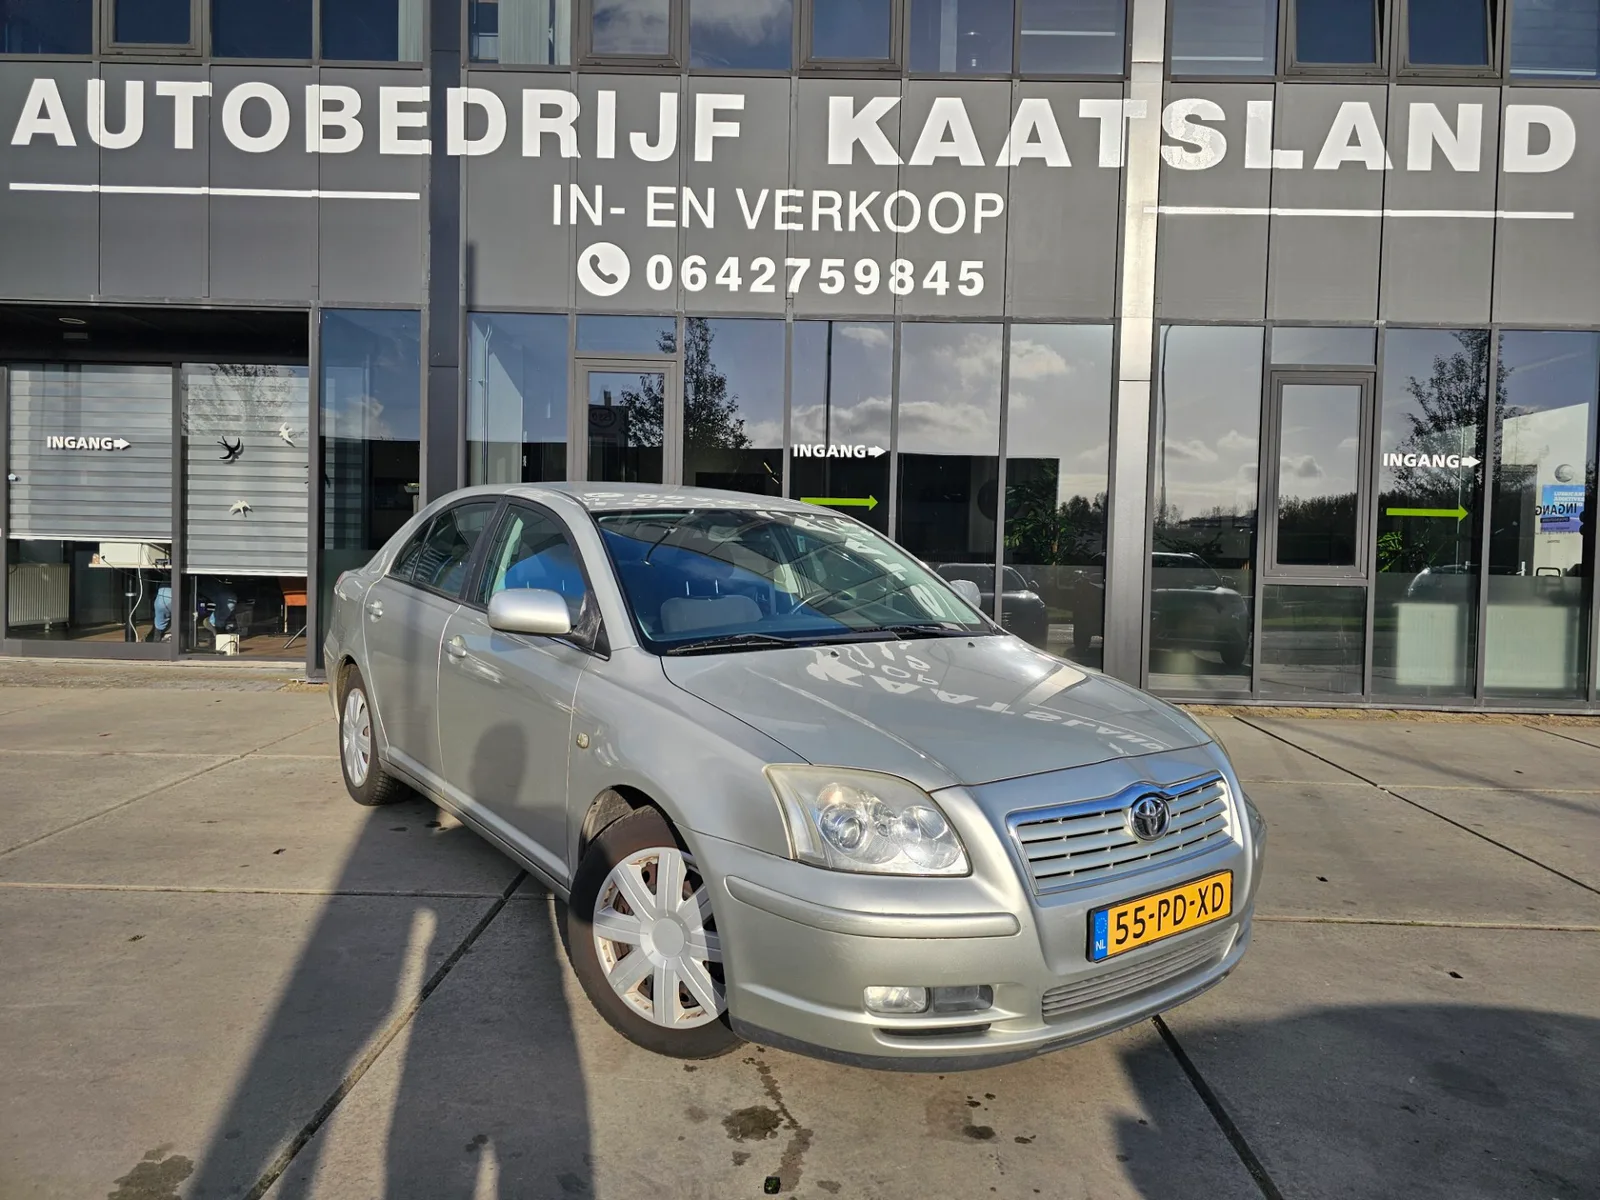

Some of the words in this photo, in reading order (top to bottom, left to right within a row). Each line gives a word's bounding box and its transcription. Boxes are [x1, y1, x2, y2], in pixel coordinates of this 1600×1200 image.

[11, 78, 746, 163] AUTOBEDRIJF
[828, 95, 1577, 173] KAATSLAND
[552, 183, 626, 227] IN-
[646, 185, 716, 229] EN
[735, 188, 1005, 235] VERKOOP
[646, 253, 986, 297] 0642759845
[46, 436, 113, 450] INGANG
[793, 443, 867, 459] INGANG
[1383, 453, 1460, 469] INGANG
[1115, 881, 1225, 945] 55-PD-XD
[1095, 939, 1107, 951] NL
